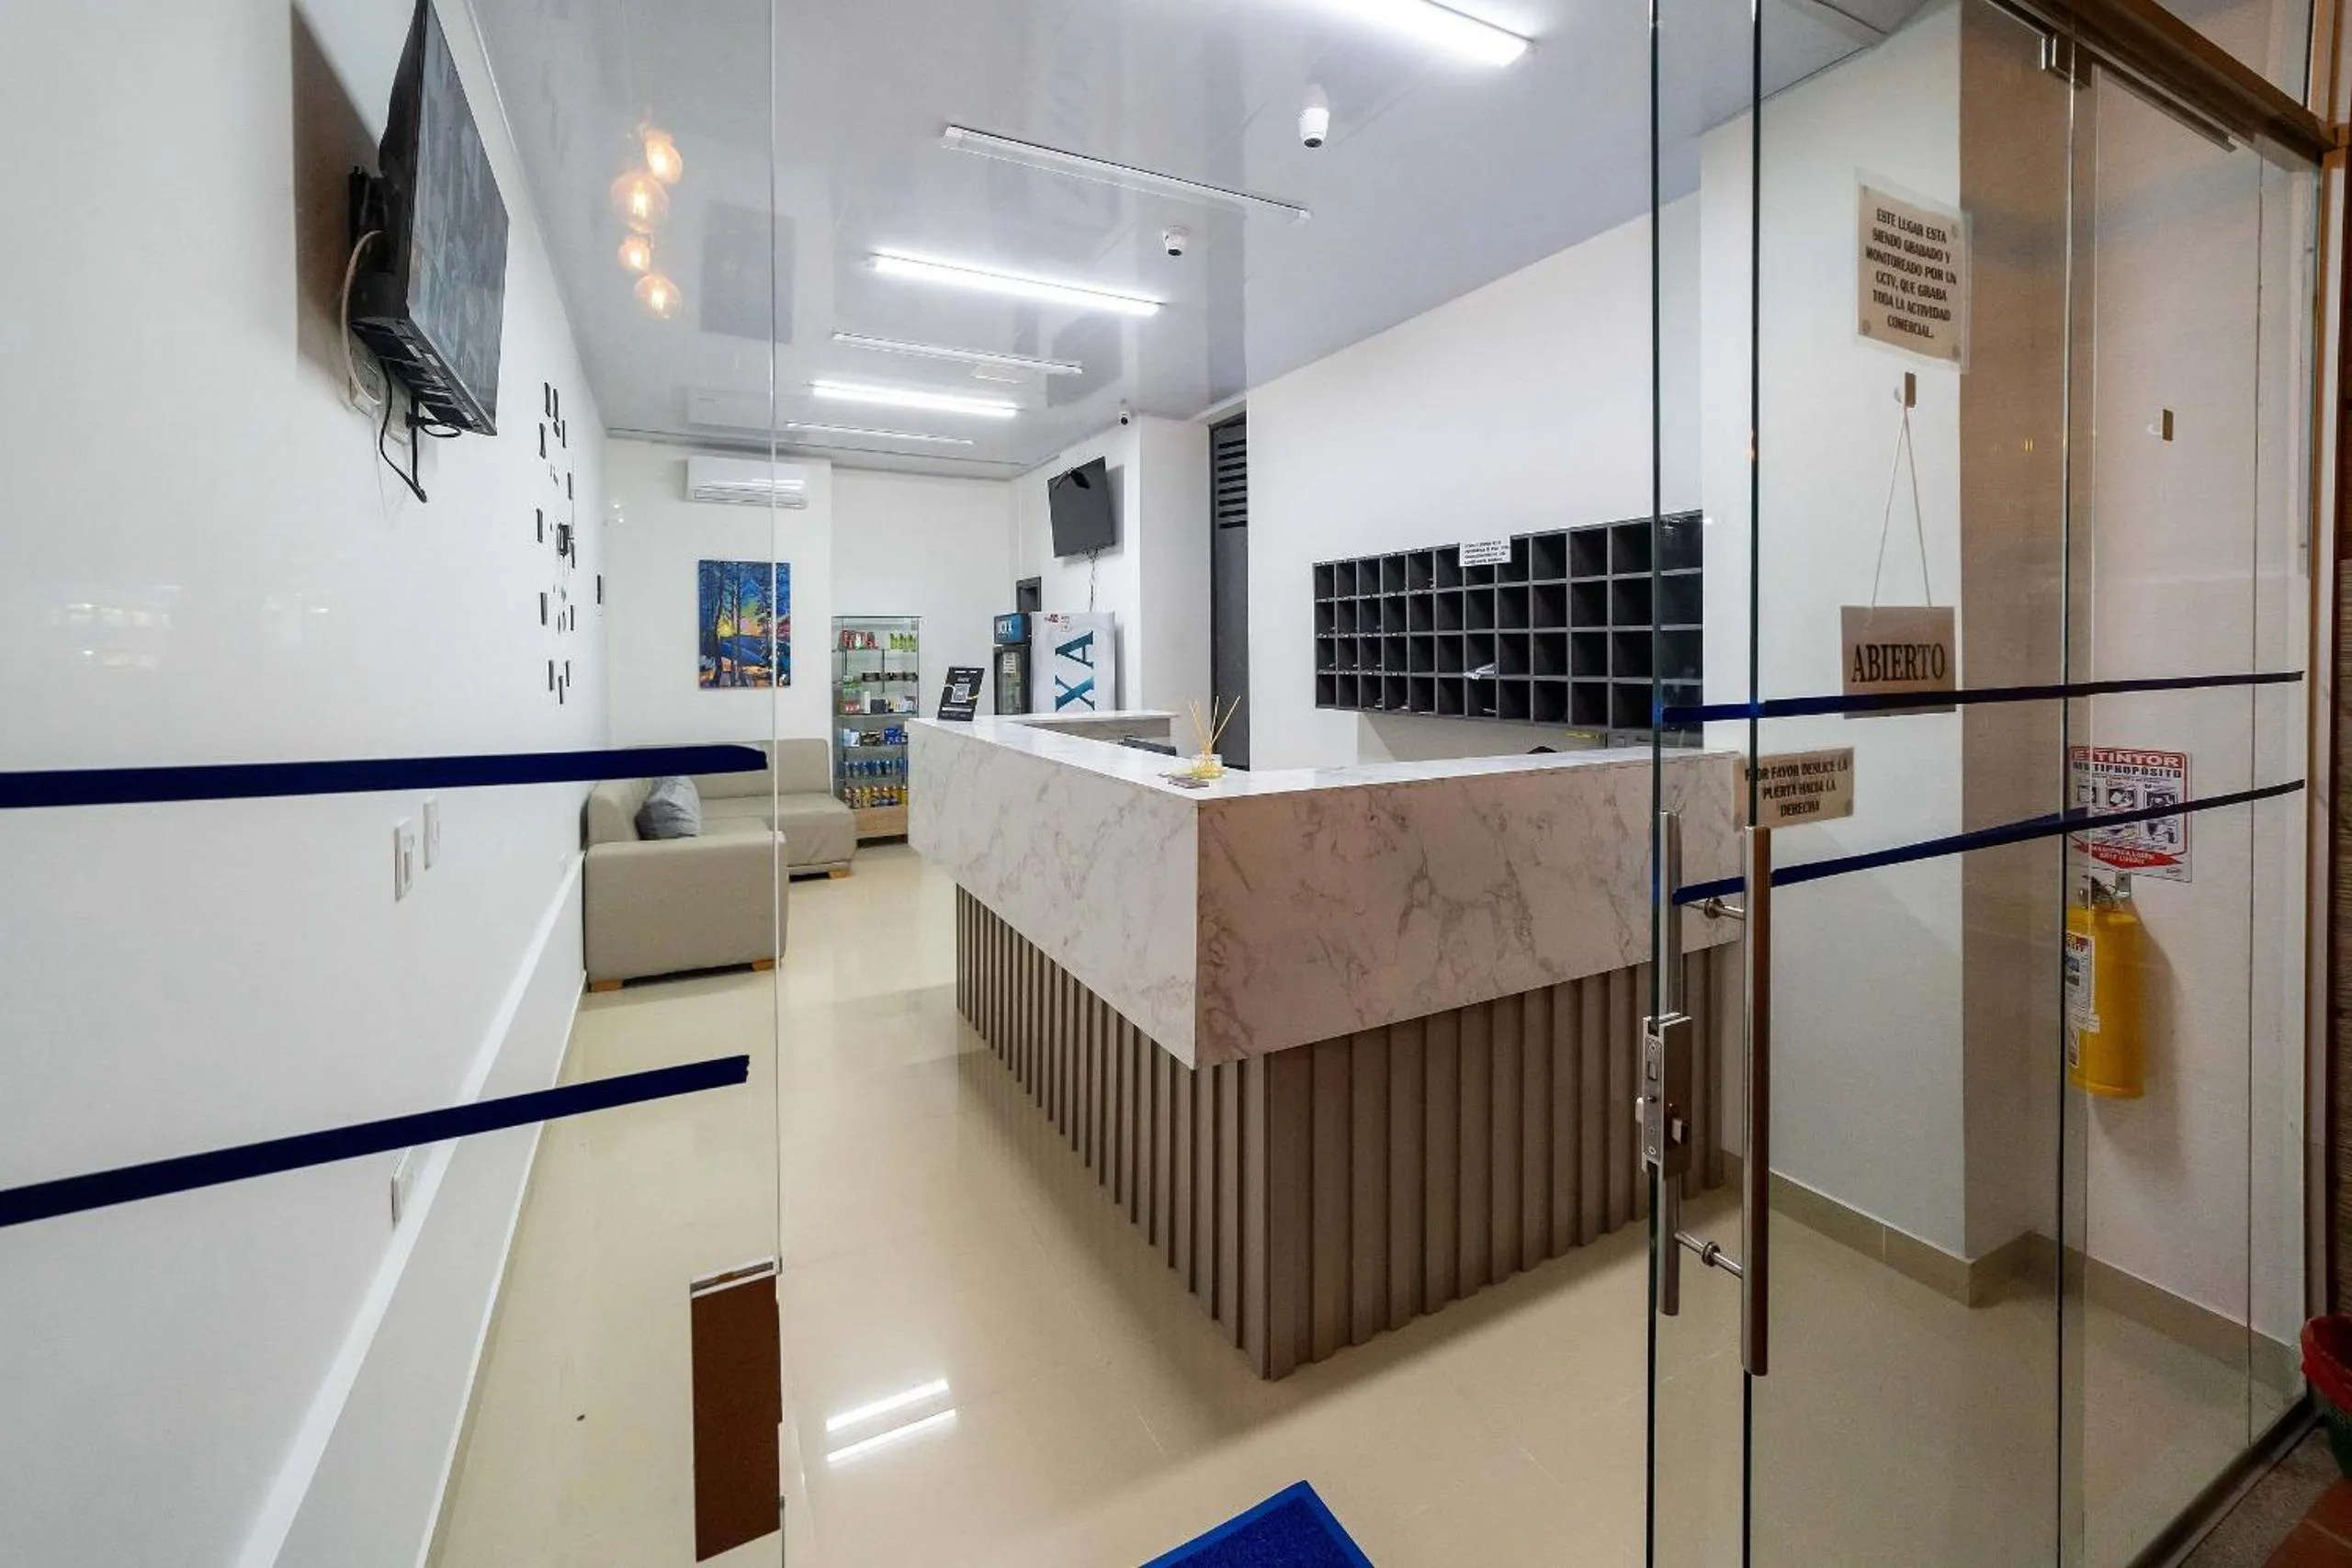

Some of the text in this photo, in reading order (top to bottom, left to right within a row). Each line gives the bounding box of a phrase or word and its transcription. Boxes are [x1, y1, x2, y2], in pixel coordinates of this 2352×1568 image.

[1876, 208, 1947, 244] ESTE LUGAR ESTA
[1872, 228, 1951, 264] SIENDO GRABADO Y
[1866, 246, 1957, 285] MONITOREADO POR UN
[1875, 270, 1947, 301] CCTV, QUE GRABA
[1873, 289, 1951, 321] TODA LA ACTIVIDAD
[1851, 643, 1946, 682] ABIERTO
[1771, 764, 1799, 780] FAVOR
[1801, 760, 1834, 776] DESLICE
[1837, 757, 1849, 773] LA
[2073, 749, 2180, 767] ETINTOR
[1763, 779, 1837, 800] PUERTA HACIA LA
[1781, 800, 1820, 818] DERECHA
